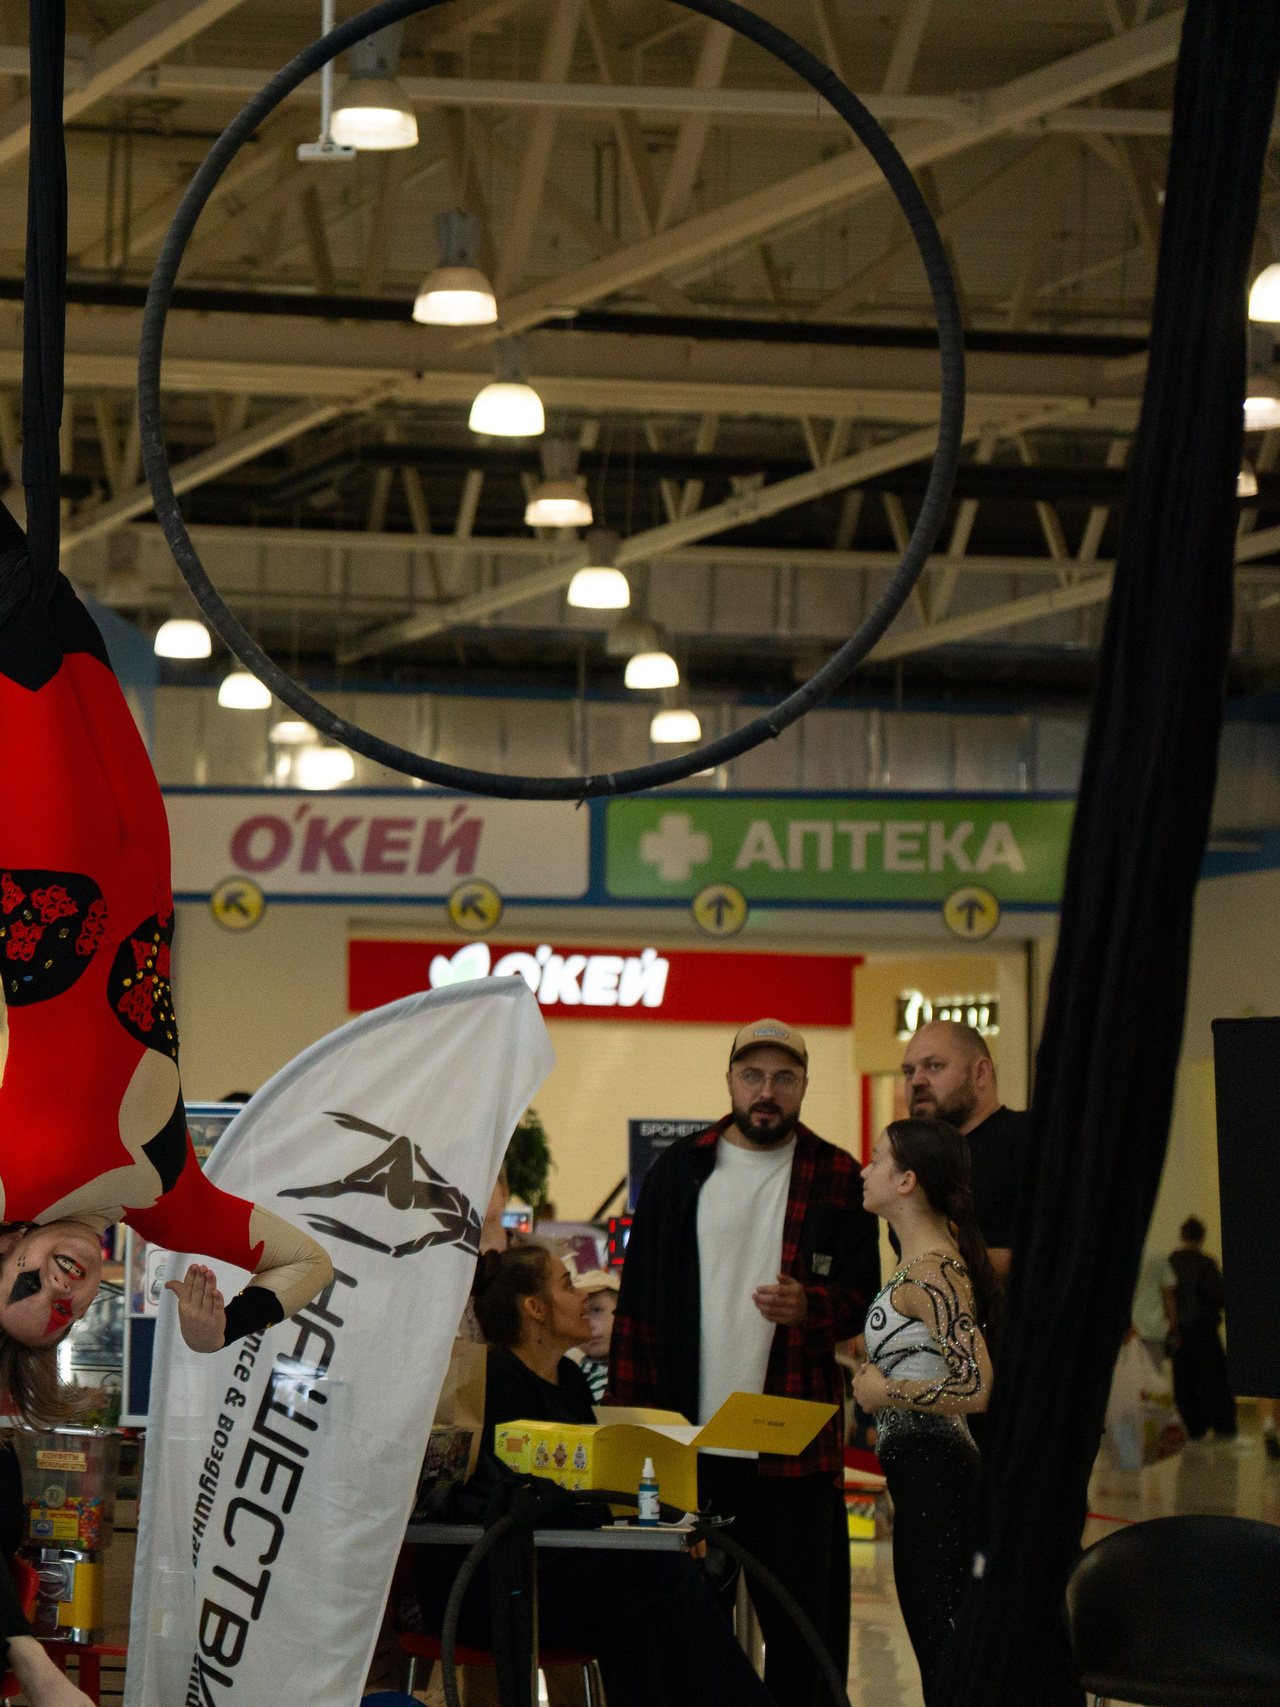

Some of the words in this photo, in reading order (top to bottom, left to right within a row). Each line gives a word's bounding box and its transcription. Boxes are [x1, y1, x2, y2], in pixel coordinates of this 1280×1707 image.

[229, 803, 484, 875] О'КЕЙ
[733, 819, 1027, 873] АПТЕКА
[224, 1386, 247, 1408] &
